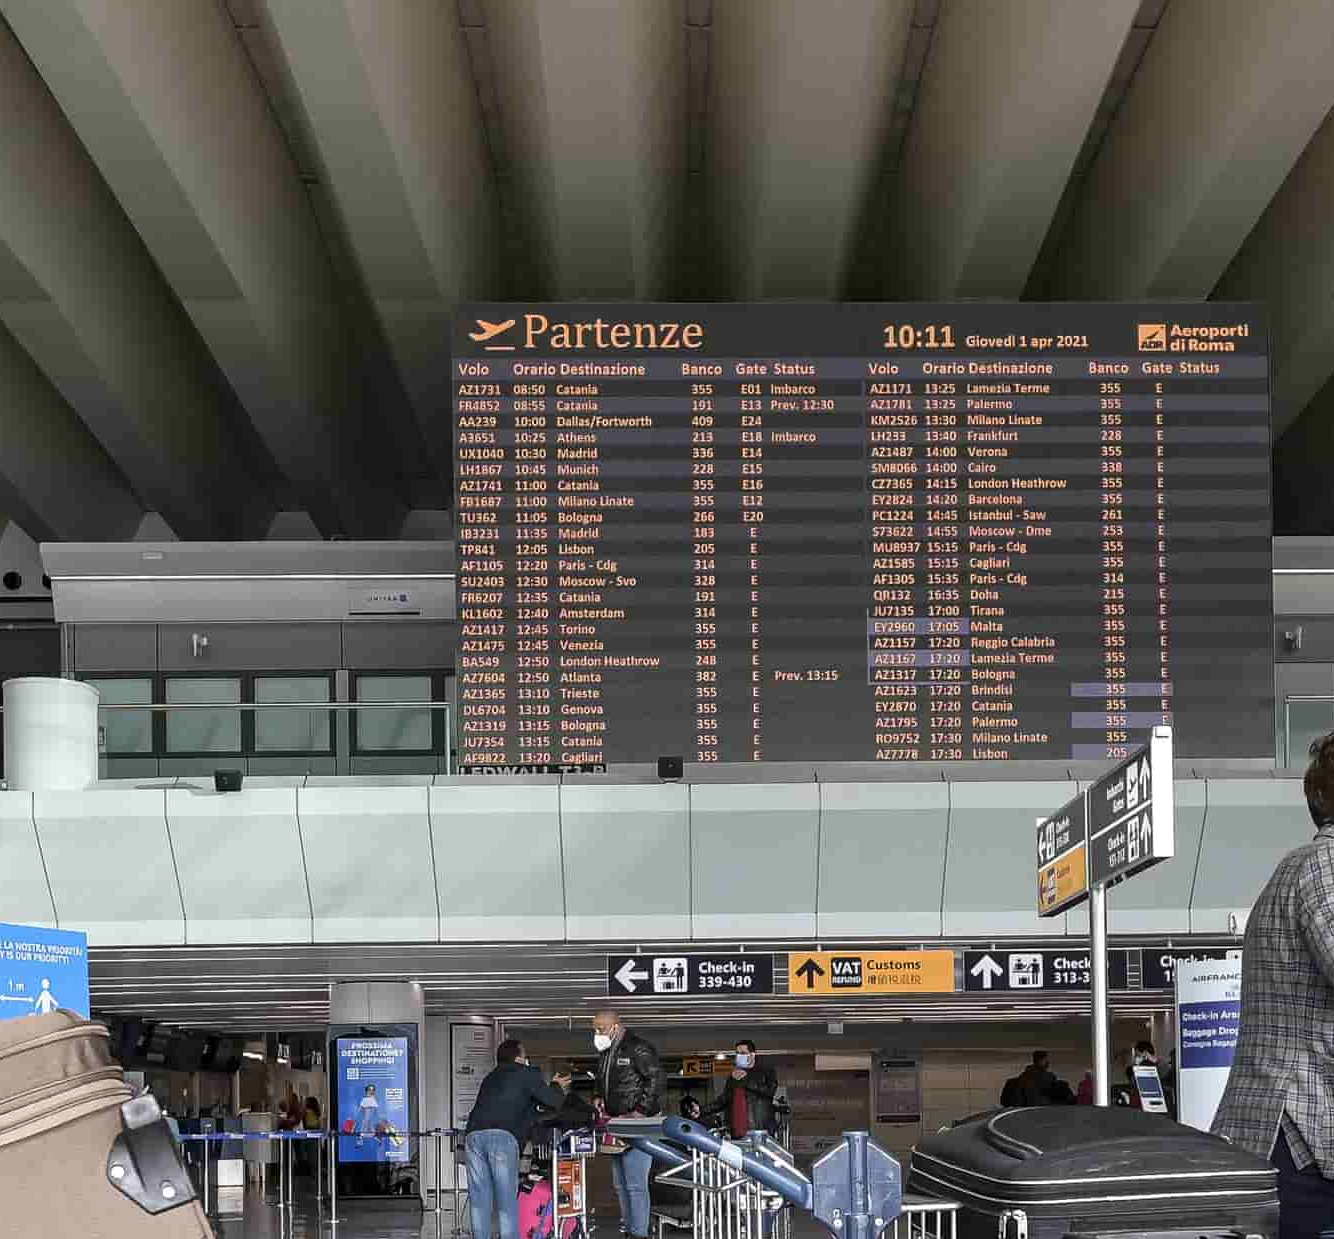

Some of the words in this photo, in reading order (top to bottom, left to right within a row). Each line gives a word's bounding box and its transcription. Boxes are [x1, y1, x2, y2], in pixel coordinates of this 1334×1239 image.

[523, 314, 703, 348] Partenze
[1170, 324, 1249, 339] Aeroporti
[883, 325, 955, 348] 10:11
[1019, 336, 1027, 347] 1
[1030, 337, 1053, 350] apr
[1056, 336, 1088, 348] 2021
[1170, 339, 1185, 351] di
[1188, 339, 1235, 351] Roma
[458, 363, 490, 376] Volo
[513, 363, 556, 376] Orario
[560, 363, 646, 376] Destinazione
[681, 363, 722, 376] Banco
[735, 363, 767, 376] Gate
[773, 363, 815, 376] Status
[868, 363, 899, 375] Volo
[922, 362, 965, 375] Orario
[969, 362, 1053, 375] Destinazione
[1088, 362, 1129, 375] Banco
[1142, 362, 1172, 375] Gate
[1179, 362, 1220, 375] Status
[459, 384, 500, 395] AZ1731
[514, 384, 545, 395] 08:50
[556, 384, 598, 395] Catania
[692, 384, 713, 394] 355
[741, 384, 761, 394] E01
[771, 384, 816, 394] Imbarco
[870, 384, 912, 394] AZ1171
[925, 383, 955, 394] 13:25
[967, 383, 1011, 393] Lamezia
[1015, 383, 1050, 393] Terme
[1100, 383, 1121, 393] 355
[1156, 383, 1163, 393] E
[514, 400, 545, 411] 08:55
[557, 400, 598, 411] Catania
[692, 400, 713, 411] 191
[741, 400, 762, 410] E13
[771, 400, 800, 410] Prev.
[803, 400, 835, 410] 12:30
[459, 417, 496, 427] AA239
[515, 416, 545, 427] 10:00
[557, 416, 651, 428] Dallas/Fortworth
[692, 416, 713, 426] 409
[742, 416, 762, 426] E24
[871, 431, 906, 441] LH233
[926, 431, 956, 441] 13:40
[967, 430, 1018, 441] Frankfurt
[1101, 430, 1121, 440] 228
[1157, 430, 1163, 440] E
[460, 512, 496, 523] TU362
[516, 512, 547, 523] 11:05
[558, 512, 603, 524] Bologna
[694, 512, 714, 522] 266
[744, 512, 763, 522] E20
[874, 606, 915, 616] JU7135
[929, 605, 959, 616] 17:00
[970, 605, 1004, 616] Tirana
[1104, 604, 1125, 615] 355
[1160, 604, 1167, 615] E
[463, 673, 505, 683] AZ7604
[518, 673, 549, 684] 12:50
[560, 672, 601, 683] Atlanta
[697, 671, 717, 681] 382
[753, 671, 760, 681] E
[774, 670, 804, 681] Prev.
[807, 670, 839, 681] 13:15
[876, 748, 919, 759] AZ7778
[931, 748, 961, 759] 17:30
[973, 748, 1008, 759] Lisbon
[1107, 748, 1128, 758] 205
[3, 940, 14, 950] LA
[16, 941, 46, 953] NOSTRA
[5, 950, 14, 960] IS
[16, 951, 32, 961] OUR
[698, 960, 755, 974] Check-in
[832, 961, 861, 974] VAT
[867, 959, 922, 971] Customs
[1054, 957, 1097, 970] Check
[698, 975, 752, 988] 339-430
[1054, 972, 1091, 984] 313-3
[1192, 973, 1241, 982] AIRFRANC
[15, 982, 26, 993] m
